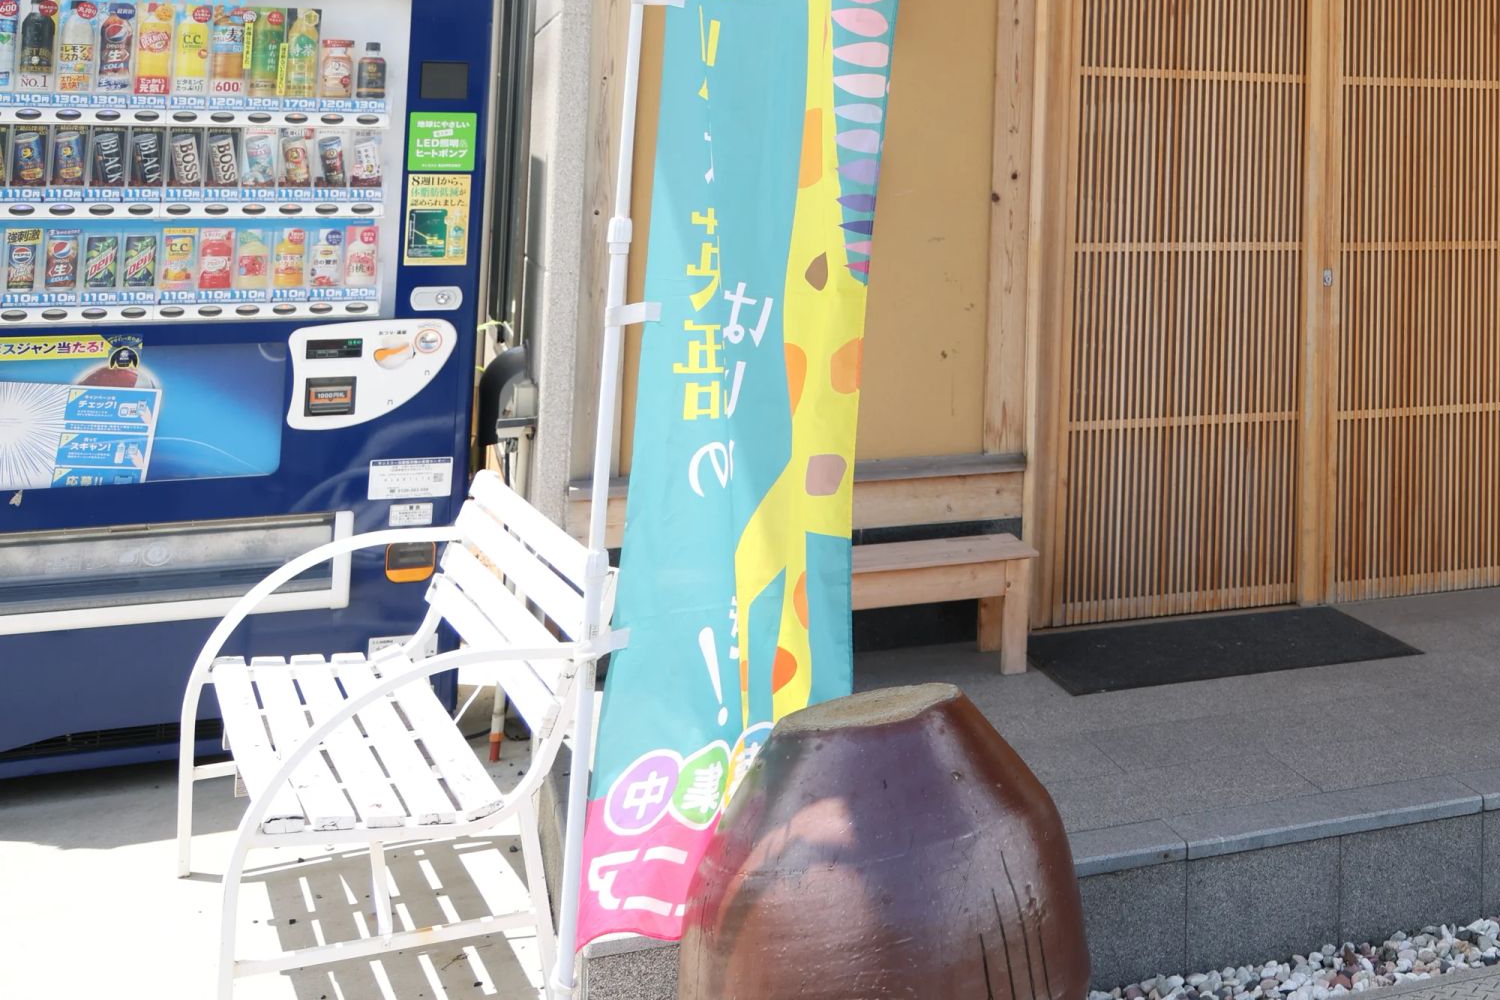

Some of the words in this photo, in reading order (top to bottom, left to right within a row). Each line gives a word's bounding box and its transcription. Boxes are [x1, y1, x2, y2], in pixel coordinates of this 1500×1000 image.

[417, 120, 470, 128] 地球にやさしい
[100, 138, 123, 183] BLACK
[140, 137, 160, 183] BLACK
[180, 143, 198, 182] BOSS
[217, 143, 236, 182] BOSS
[416, 149, 468, 158] ヒートポンプ
[78, 400, 117, 410] チェック!
[71, 442, 111, 452] スキャン!
